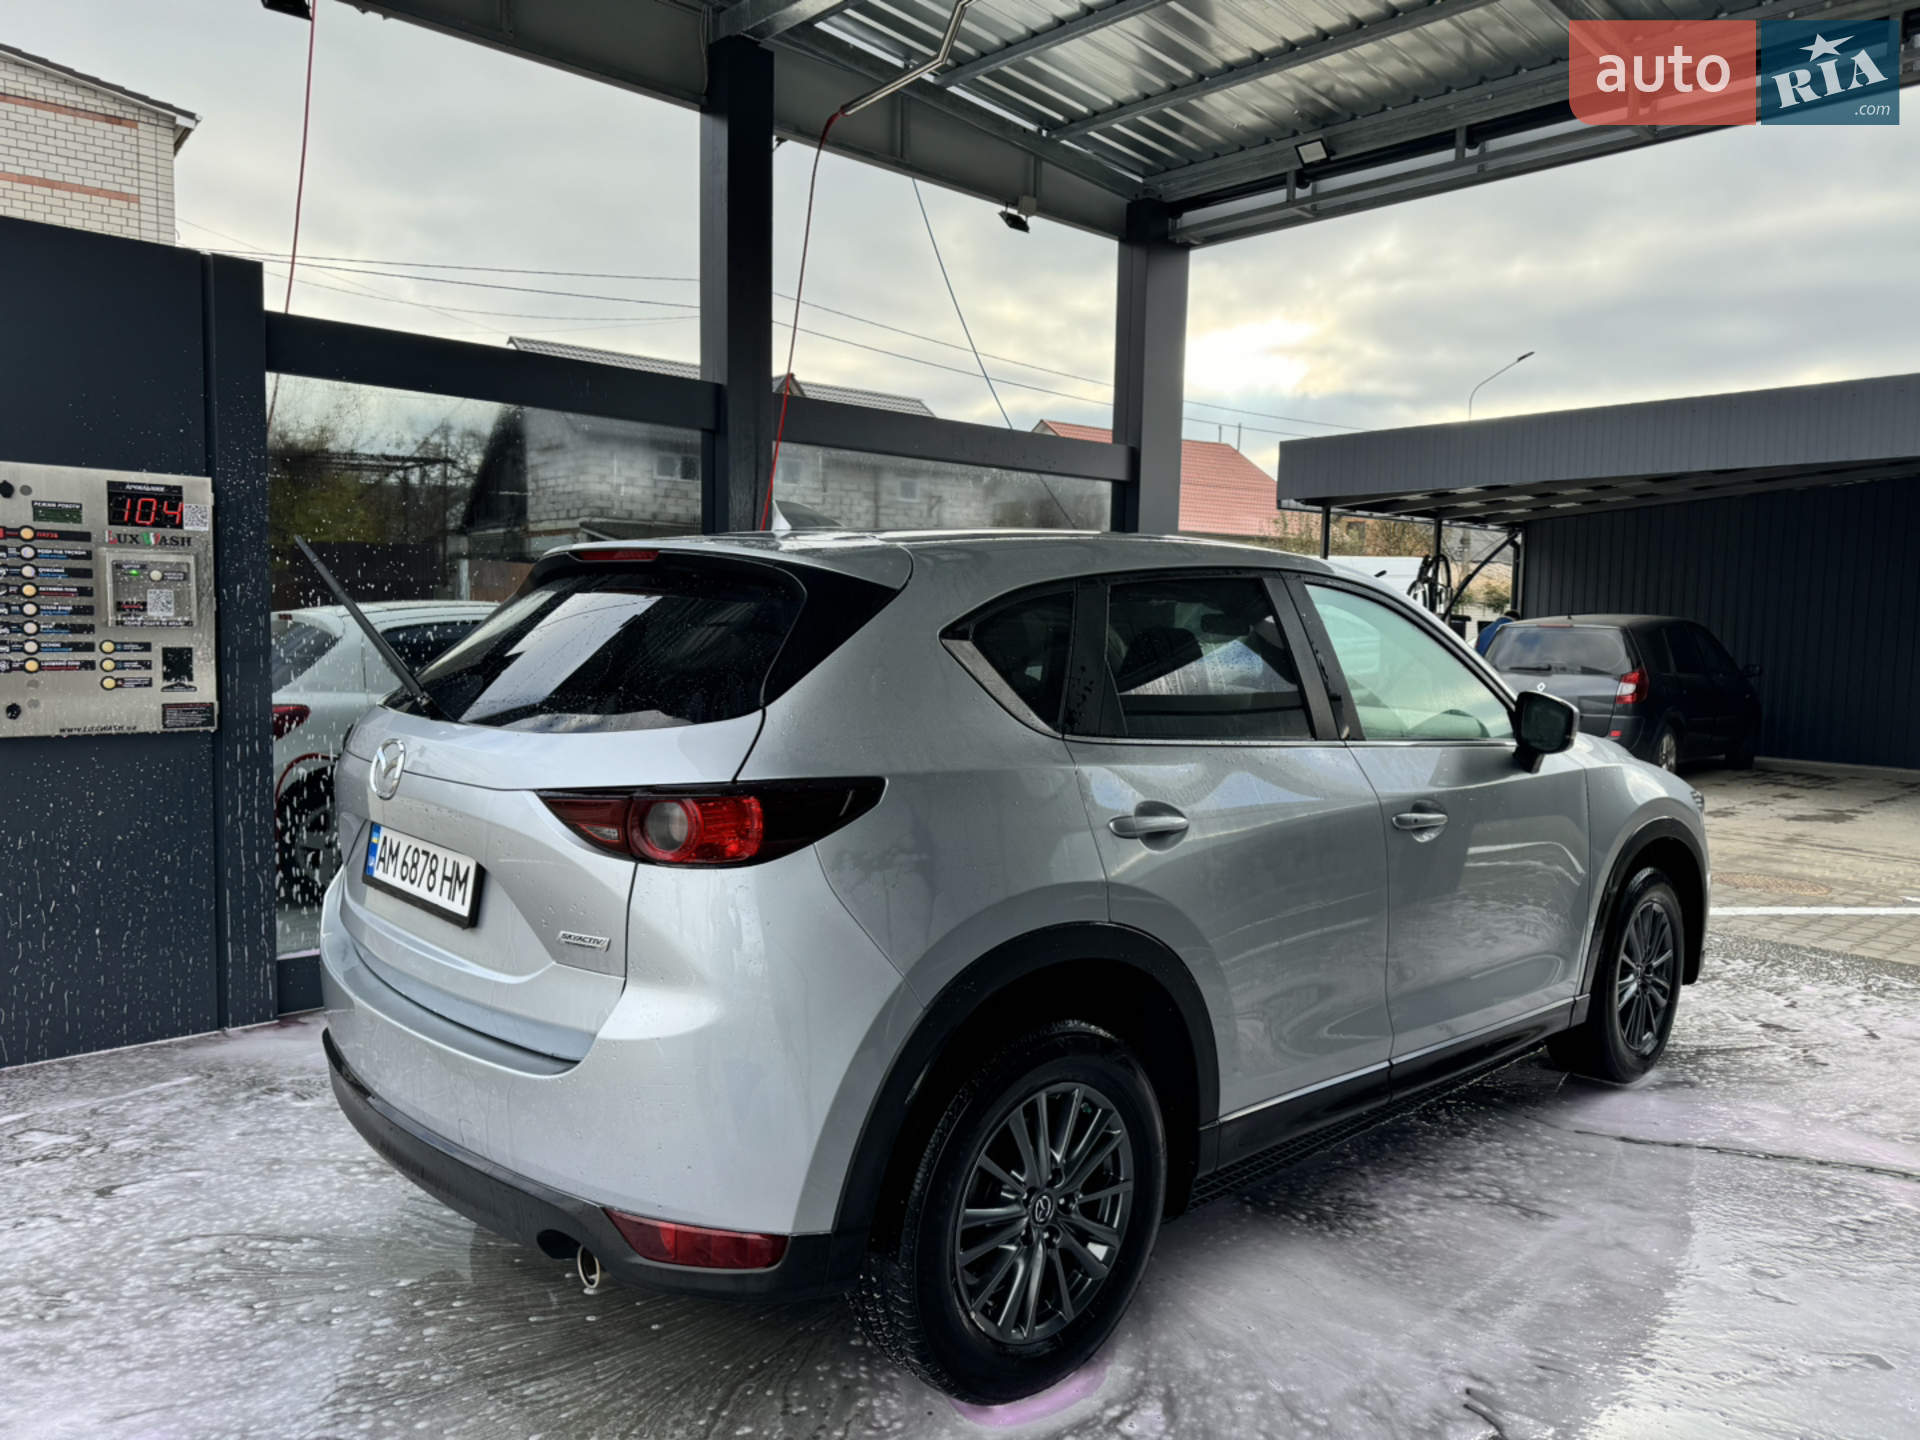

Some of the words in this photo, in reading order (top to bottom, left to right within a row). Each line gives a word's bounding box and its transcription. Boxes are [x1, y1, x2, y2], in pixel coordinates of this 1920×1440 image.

[124, 498, 183, 525] 104
[104, 530, 140, 545] LUX
[141, 532, 192, 547] WASH
[376, 836, 401, 878] AM
[400, 845, 438, 892] 6878
[439, 857, 470, 906] HM
[562, 933, 604, 945] SKYACTIV
